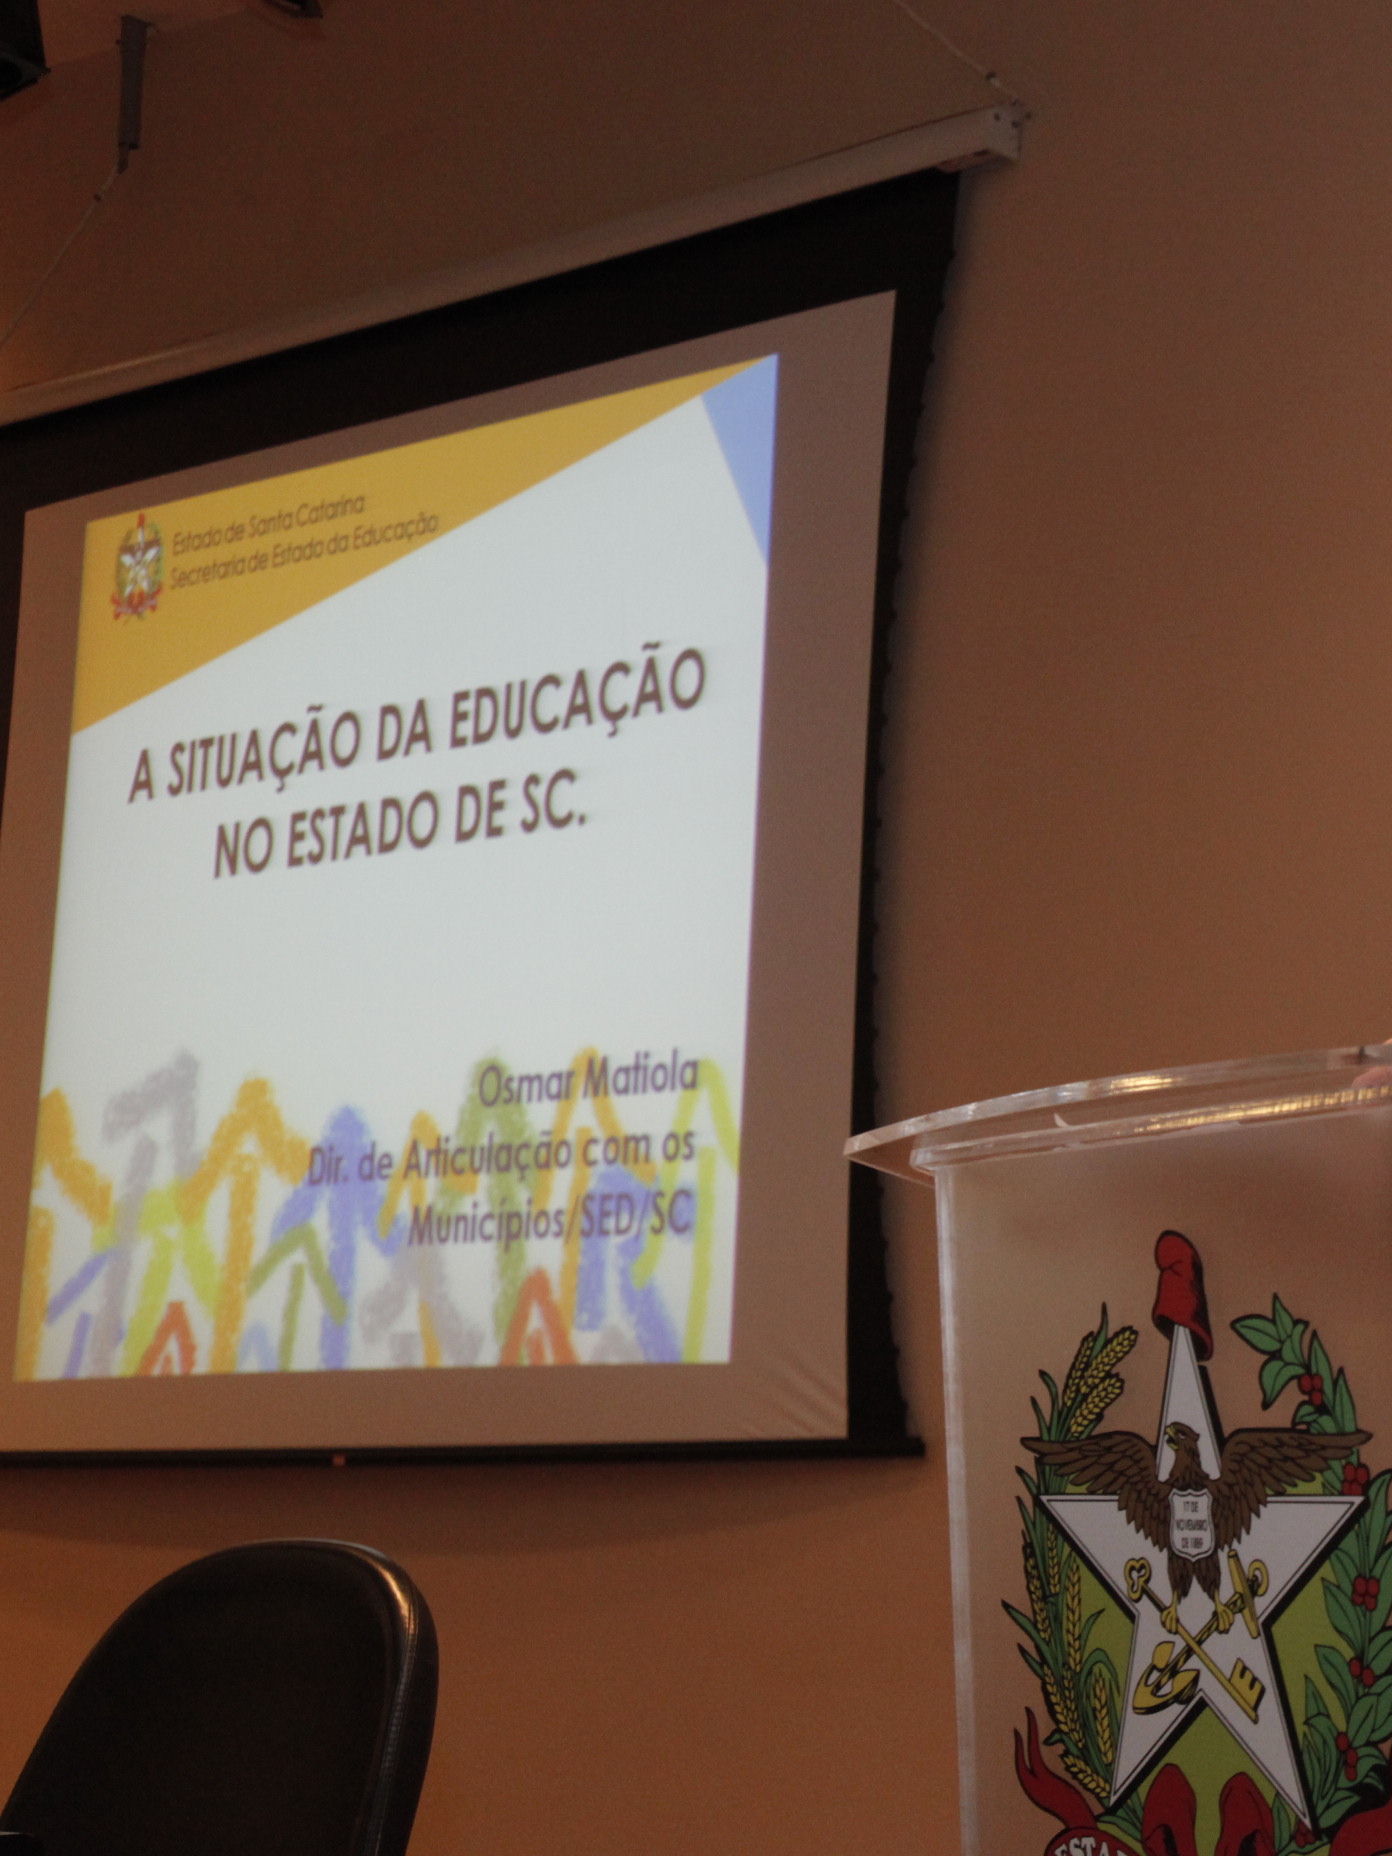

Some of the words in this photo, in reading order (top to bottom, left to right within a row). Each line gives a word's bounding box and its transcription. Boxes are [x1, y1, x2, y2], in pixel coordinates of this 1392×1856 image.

[170, 556, 246, 590] Secretaria
[248, 551, 269, 573] de
[272, 534, 325, 567] Estado
[327, 530, 349, 552] da
[353, 511, 439, 551] Educação
[173, 528, 222, 556] Estado
[224, 521, 245, 545] de
[248, 511, 293, 538] Santa
[296, 495, 365, 527] Catarina
[127, 748, 154, 803] A
[167, 703, 361, 797] SITUAÇÃO
[376, 697, 432, 762] DA
[449, 641, 706, 749] EDUCAÇÃO
[213, 817, 273, 879] NO
[287, 790, 439, 868] ESTADO
[454, 778, 507, 843] DE
[520, 768, 587, 834] SC.
[479, 1065, 575, 1107] Osmar
[583, 1048, 699, 1099] Matiola
[307, 1146, 350, 1186] Dir.
[358, 1141, 394, 1181] de
[402, 1131, 572, 1182] Articulação
[581, 1133, 651, 1166] com
[662, 1131, 696, 1161] os
[407, 1188, 693, 1253] Municípios/SED/SC
